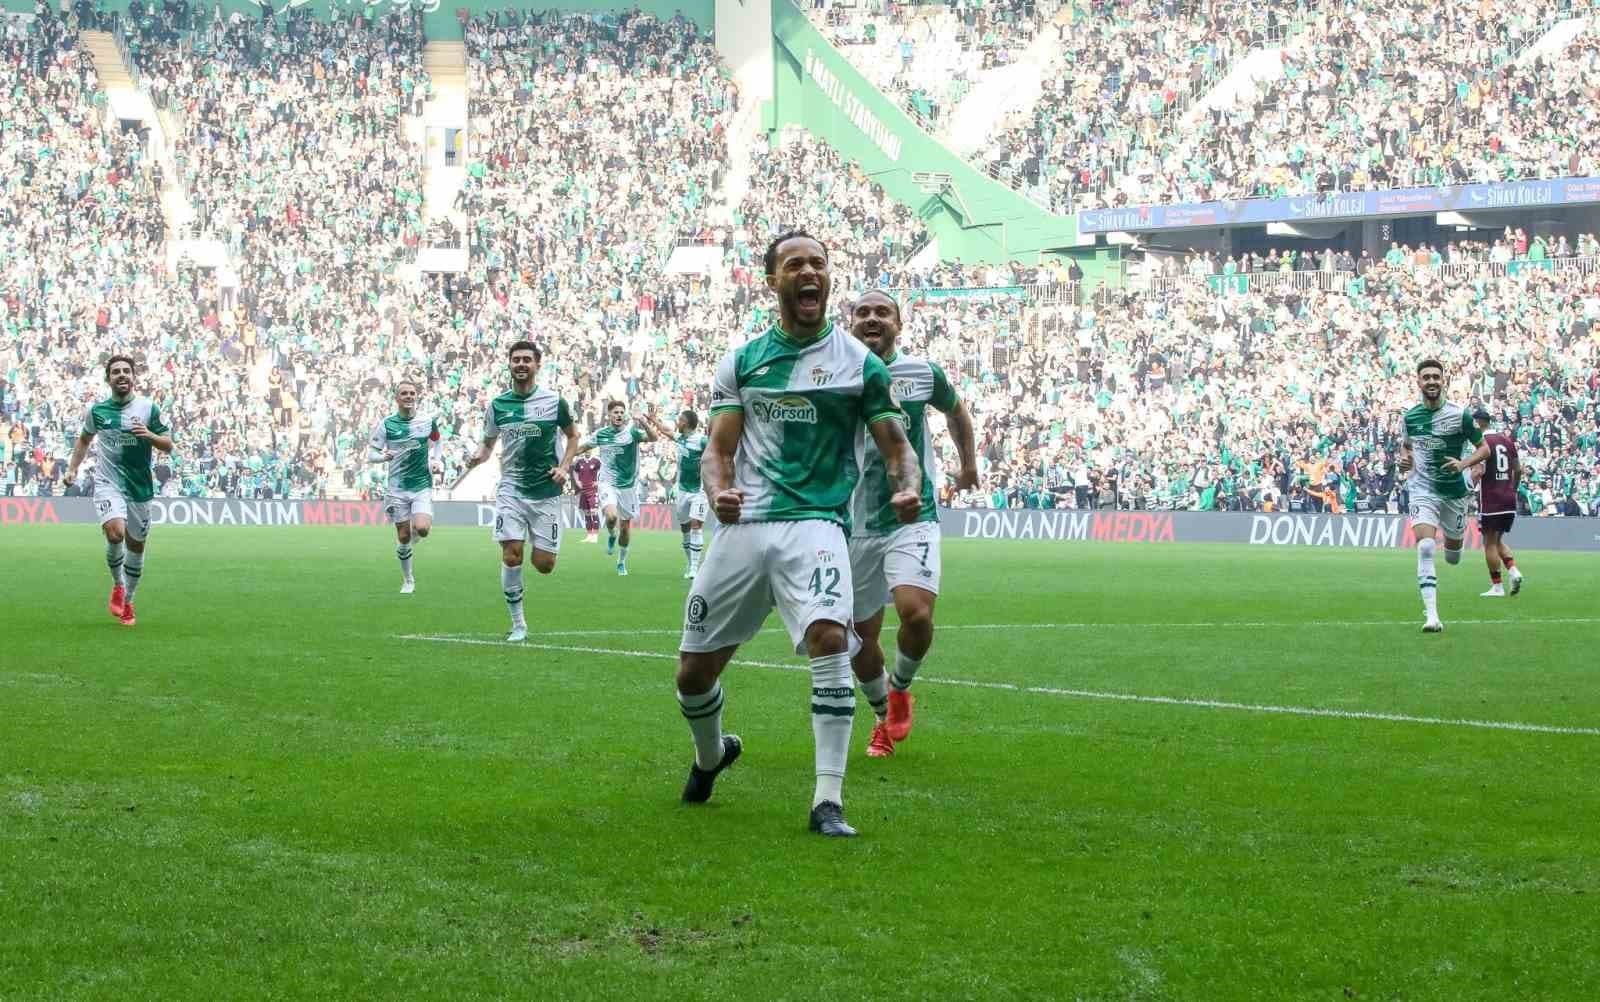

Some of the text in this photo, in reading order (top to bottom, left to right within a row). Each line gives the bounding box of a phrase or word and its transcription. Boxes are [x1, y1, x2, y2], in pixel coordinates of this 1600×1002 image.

[1495, 443, 1509, 473] 6
[150, 500, 300, 525] DONANIM
[963, 511, 1175, 543] DONANIM MEDYA
[1250, 515, 1401, 549] DONANIM
[917, 542, 930, 566] 7
[807, 567, 842, 598] 42
